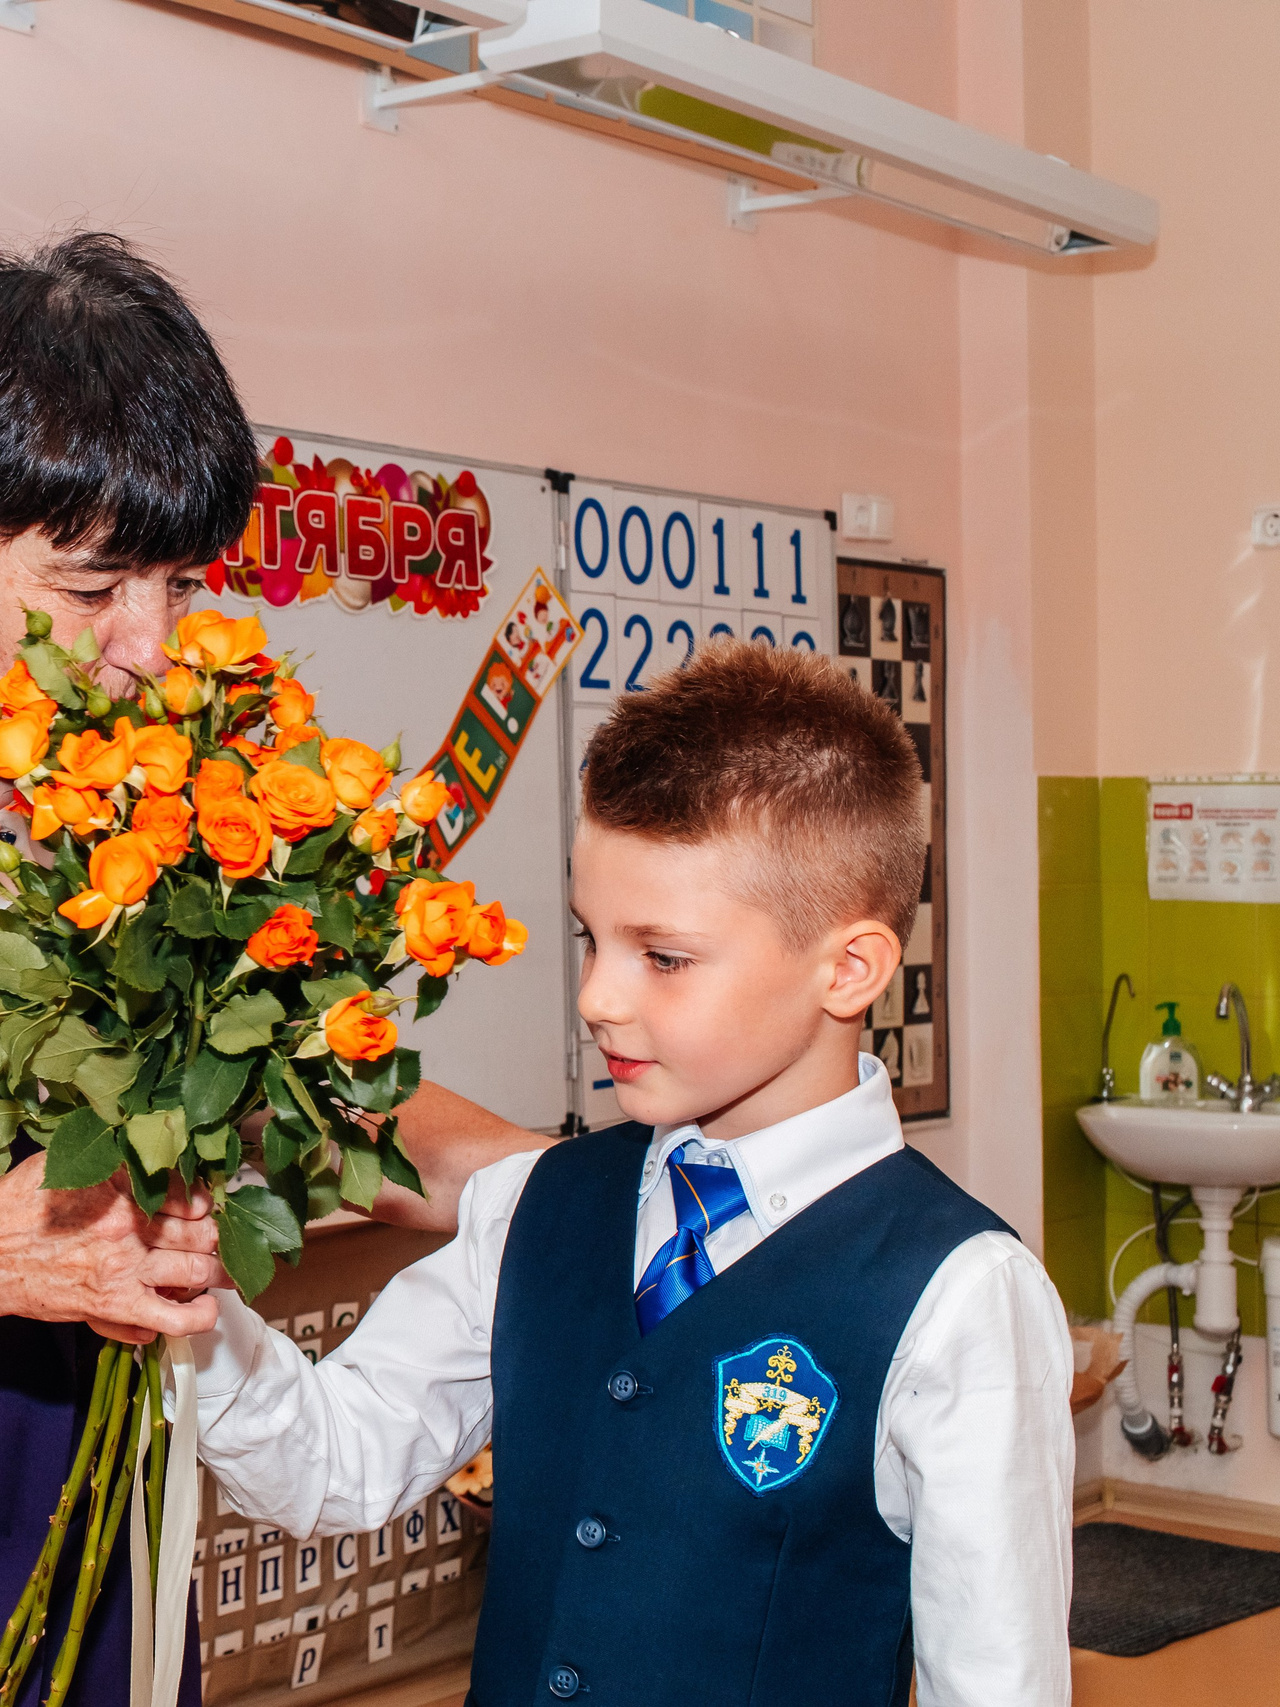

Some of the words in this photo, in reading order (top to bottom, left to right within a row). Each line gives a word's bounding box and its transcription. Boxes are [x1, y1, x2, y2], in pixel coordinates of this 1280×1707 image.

[762, 1385, 787, 1402] 319
[221, 1566, 242, 1605] Н
[260, 1556, 281, 1595] П
[299, 1546, 317, 1583] Р
[336, 1533, 355, 1570] С
[406, 1509, 424, 1544] Ф
[440, 1499, 460, 1535] Х
